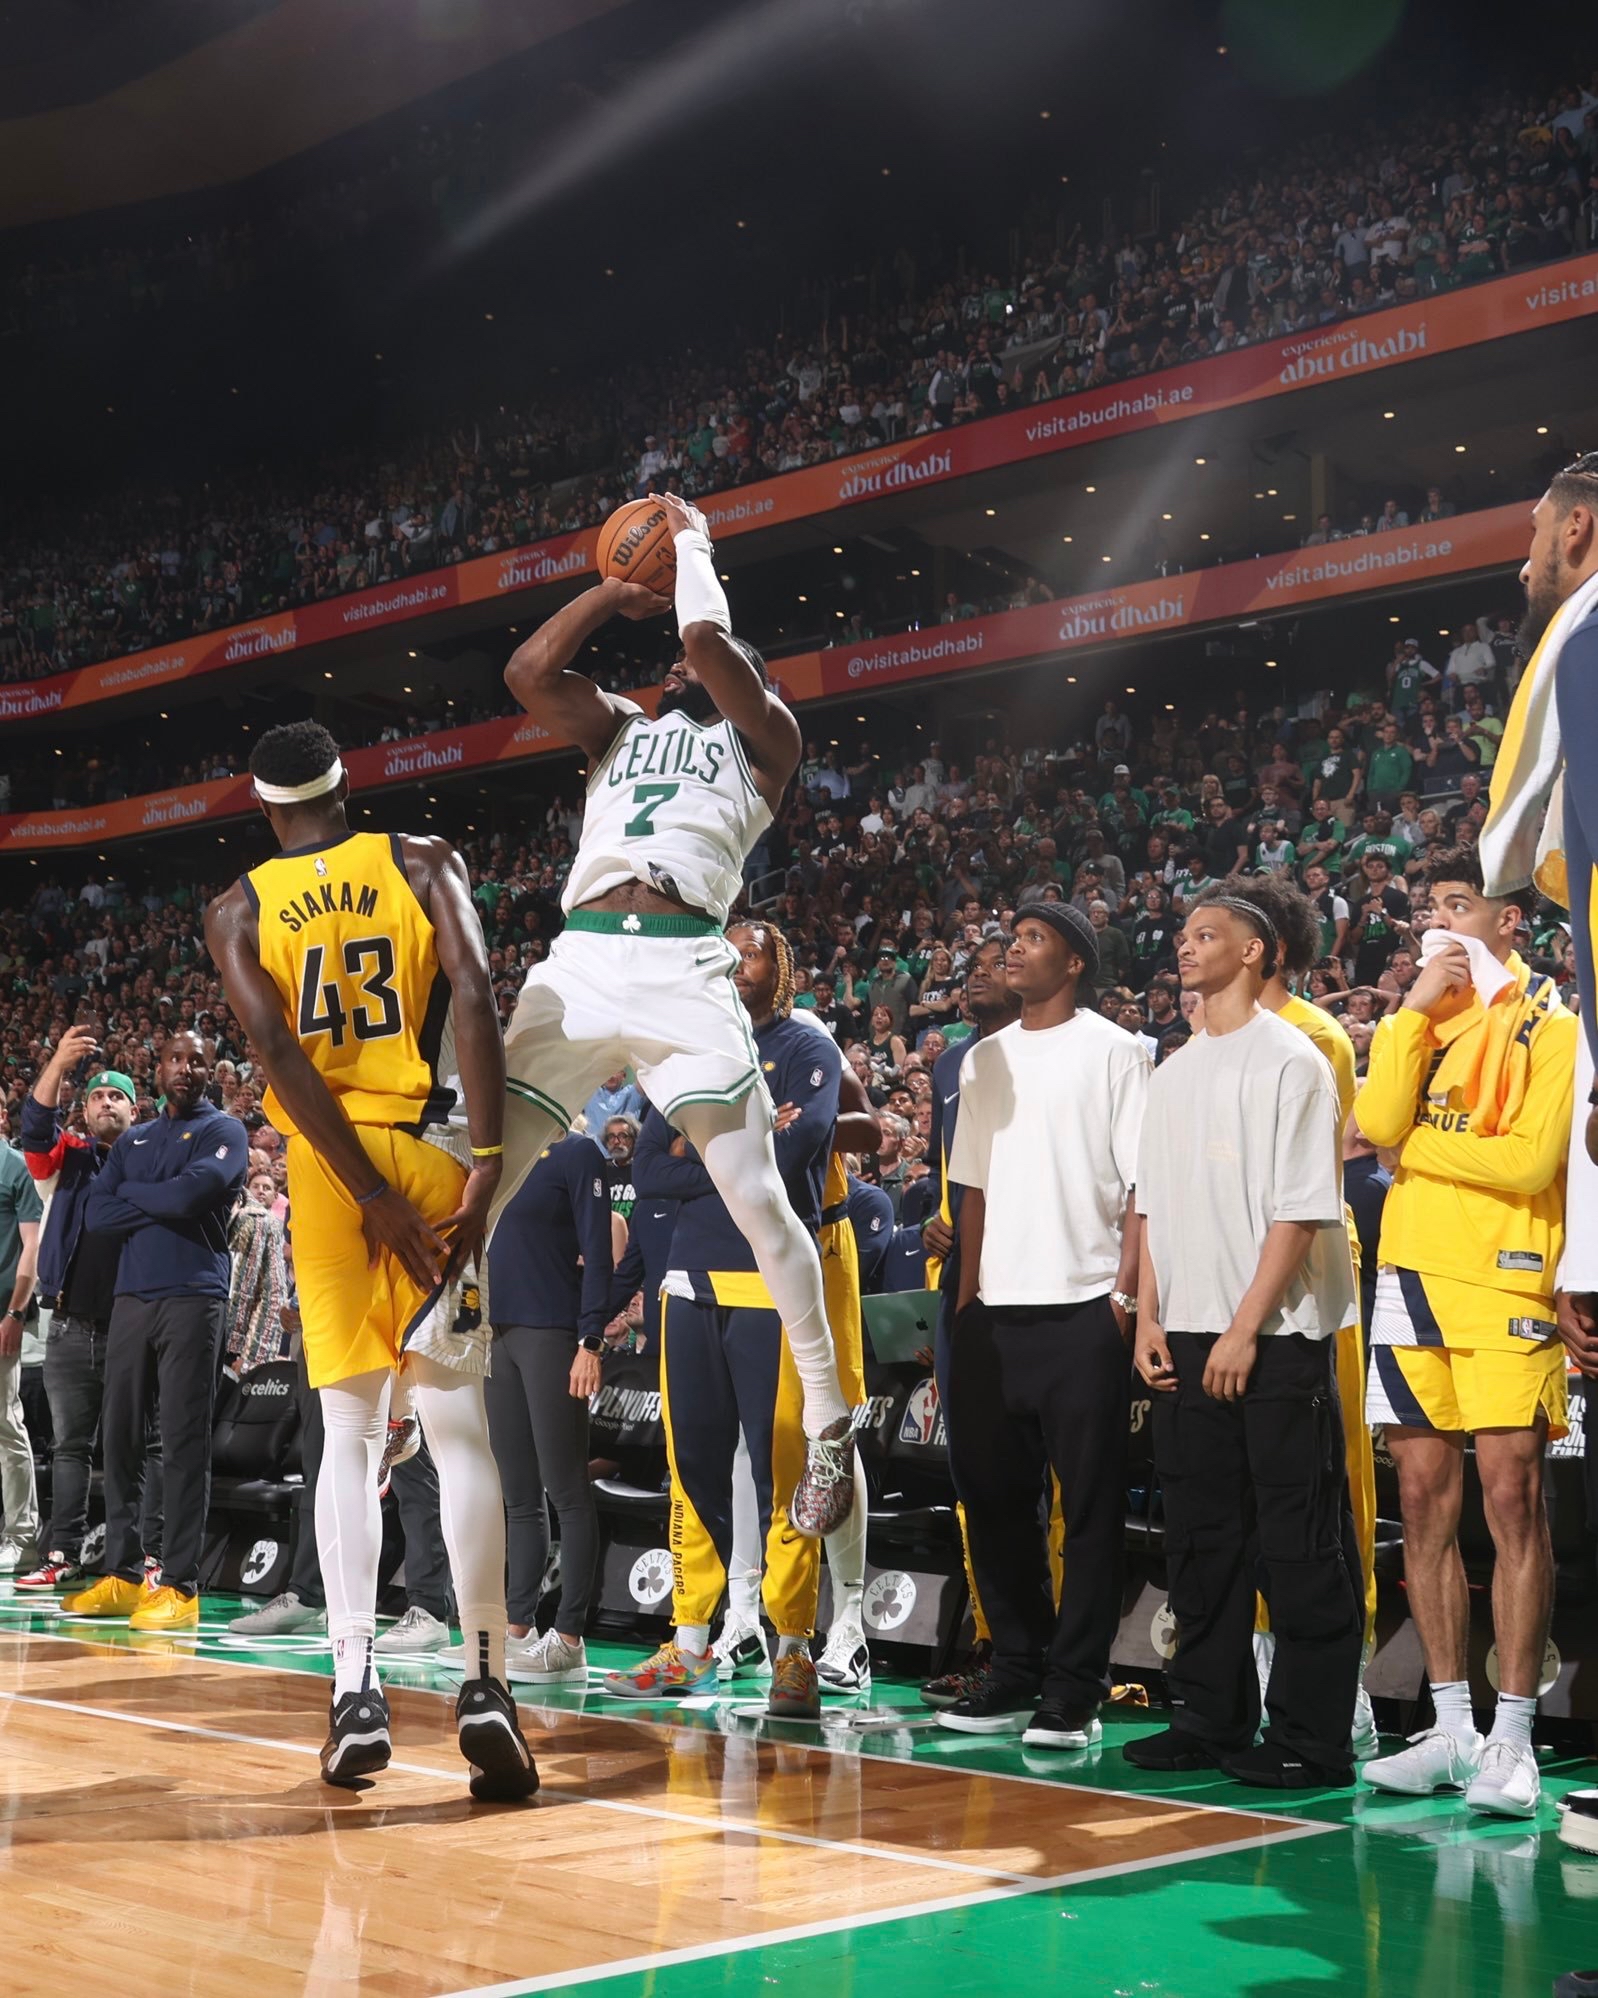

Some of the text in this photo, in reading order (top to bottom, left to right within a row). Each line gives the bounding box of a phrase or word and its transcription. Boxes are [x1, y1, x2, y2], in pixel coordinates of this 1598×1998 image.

[1526, 274, 1598, 310] visita
[1279, 322, 1427, 384] abu dhabi
[1281, 328, 1359, 358] experience
[1026, 386, 1193, 441] visitabudhabi.ae
[839, 448, 951, 499] abu dhabi
[841, 453, 901, 476] experience
[611, 509, 667, 567] Wilson
[498, 547, 587, 588] abu dhabi
[1266, 538, 1452, 591] visitabudhabi.ae
[343, 584, 448, 623] visitabudhabi.ae
[1059, 594, 1184, 640] abu dhabi
[1061, 595, 1127, 617] experience
[225, 626, 296, 661] abu dhabi
[847, 632, 983, 678] @visitabudhabi
[0, 698, 22, 715] bu
[25, 688, 63, 712] dhabi
[384, 742, 464, 776] abu dhabi
[608, 728, 724, 788] CELTICS
[624, 782, 681, 837] 7
[279, 881, 379, 933] SIAKAM
[297, 935, 402, 1048] 43
[241, 1378, 290, 1396] @celtics
[591, 1384, 662, 1422] PLAYOFFS
[903, 1426, 919, 1439] NBA
[672, 1499, 684, 1546] INDIANA
[636, 1551, 674, 1576] CELTICS
[672, 1551, 686, 1596] PACERS
[869, 1574, 914, 1599] CELTICS
